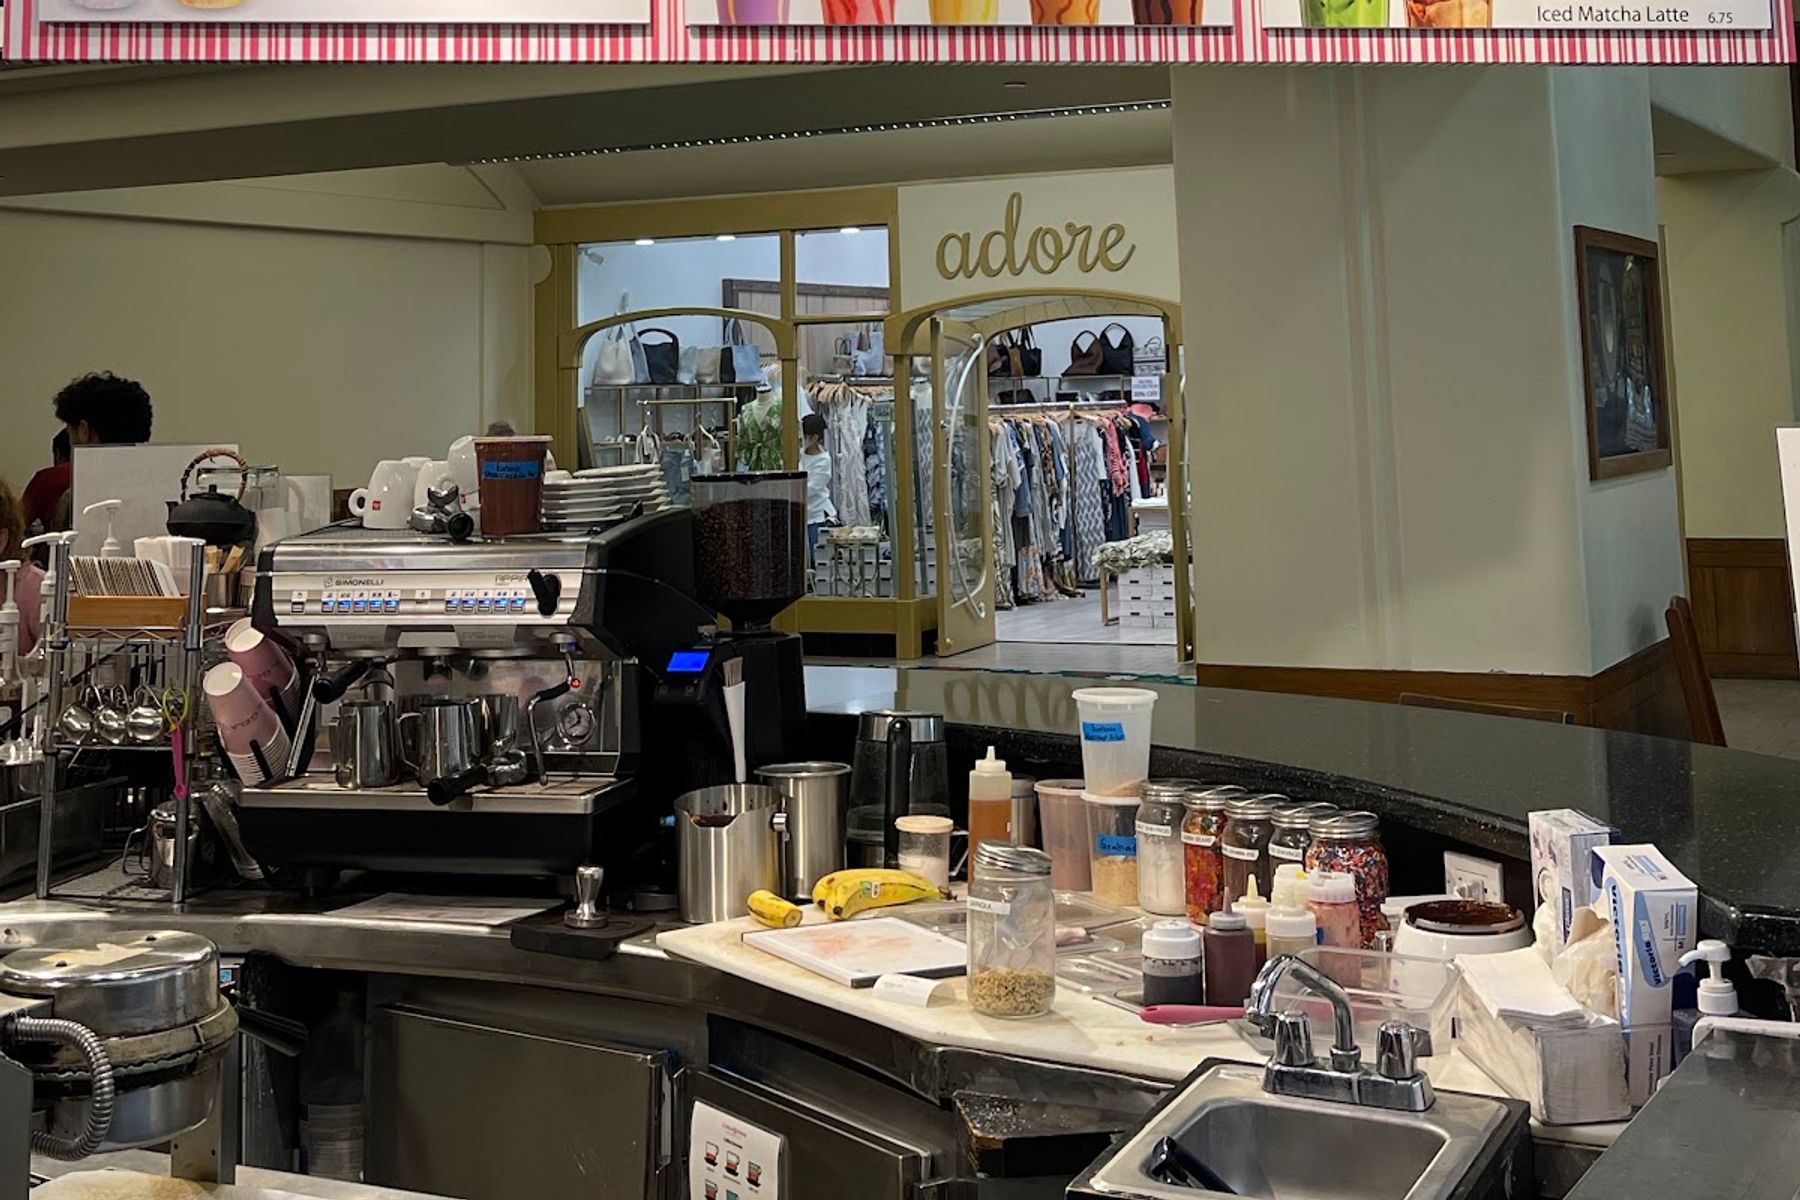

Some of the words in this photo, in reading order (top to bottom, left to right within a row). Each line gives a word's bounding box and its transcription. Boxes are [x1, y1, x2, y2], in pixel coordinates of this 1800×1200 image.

[1538, 5, 1573, 22] Iced
[1578, 5, 1641, 22] Matcha
[1646, 6, 1689, 22] Latte
[1707, 12, 1733, 24] 6.75
[936, 191, 1136, 280] adore
[1645, 940, 1662, 986] Victoria
